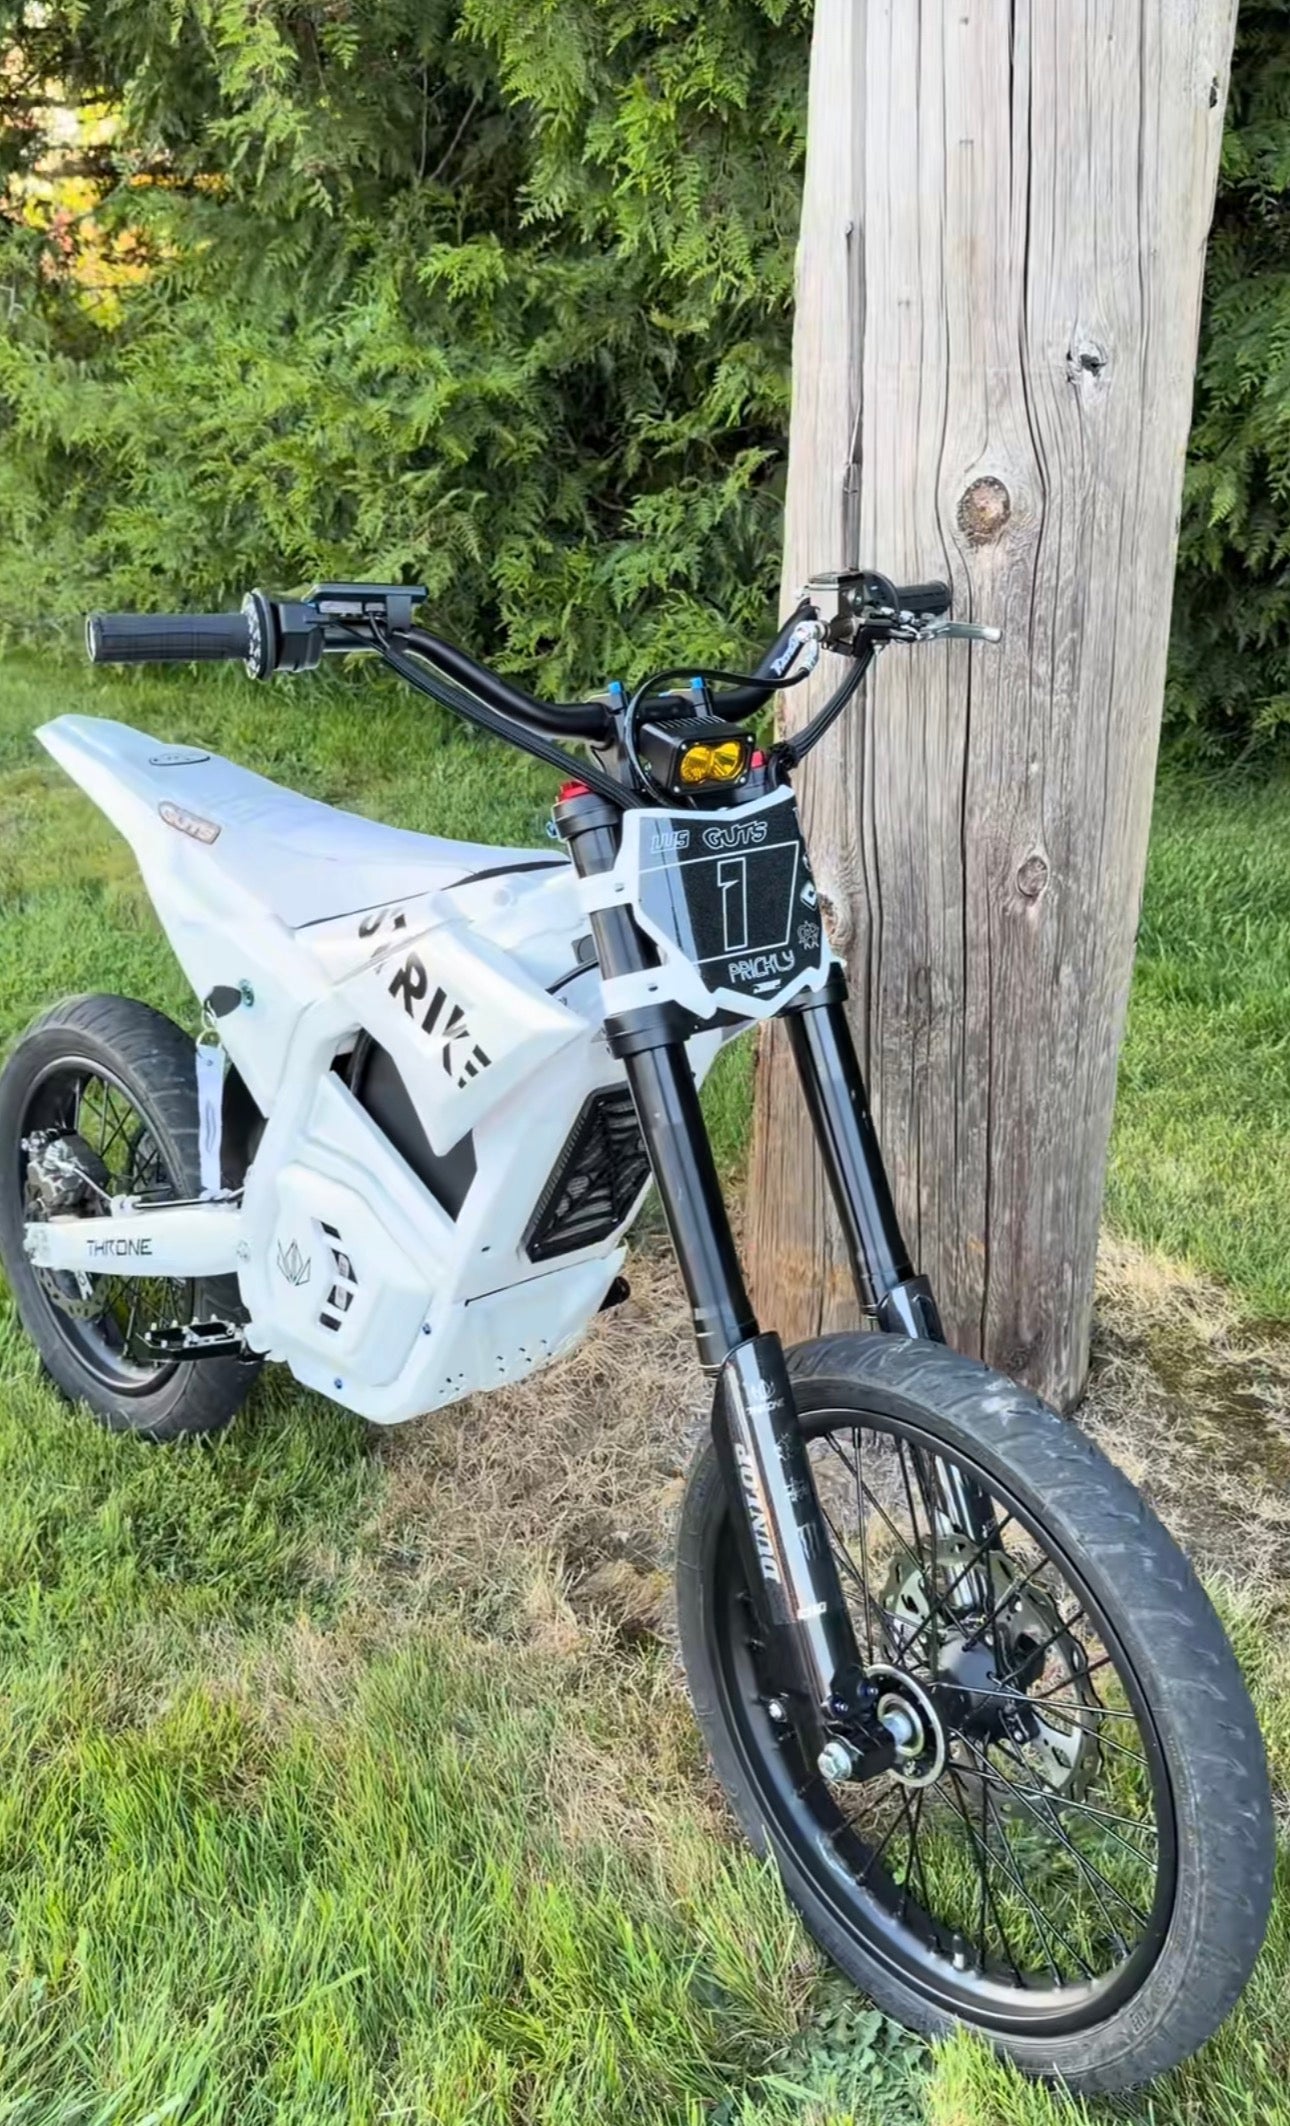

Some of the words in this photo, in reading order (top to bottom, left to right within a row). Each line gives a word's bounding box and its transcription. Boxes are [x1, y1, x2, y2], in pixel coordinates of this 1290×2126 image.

[702, 821, 767, 849] GUTS
[717, 857, 747, 951] 1
[728, 950, 795, 983] PRICKLY
[86, 1238, 153, 1256] THRONE
[734, 1443, 781, 1584] DUNLOP
